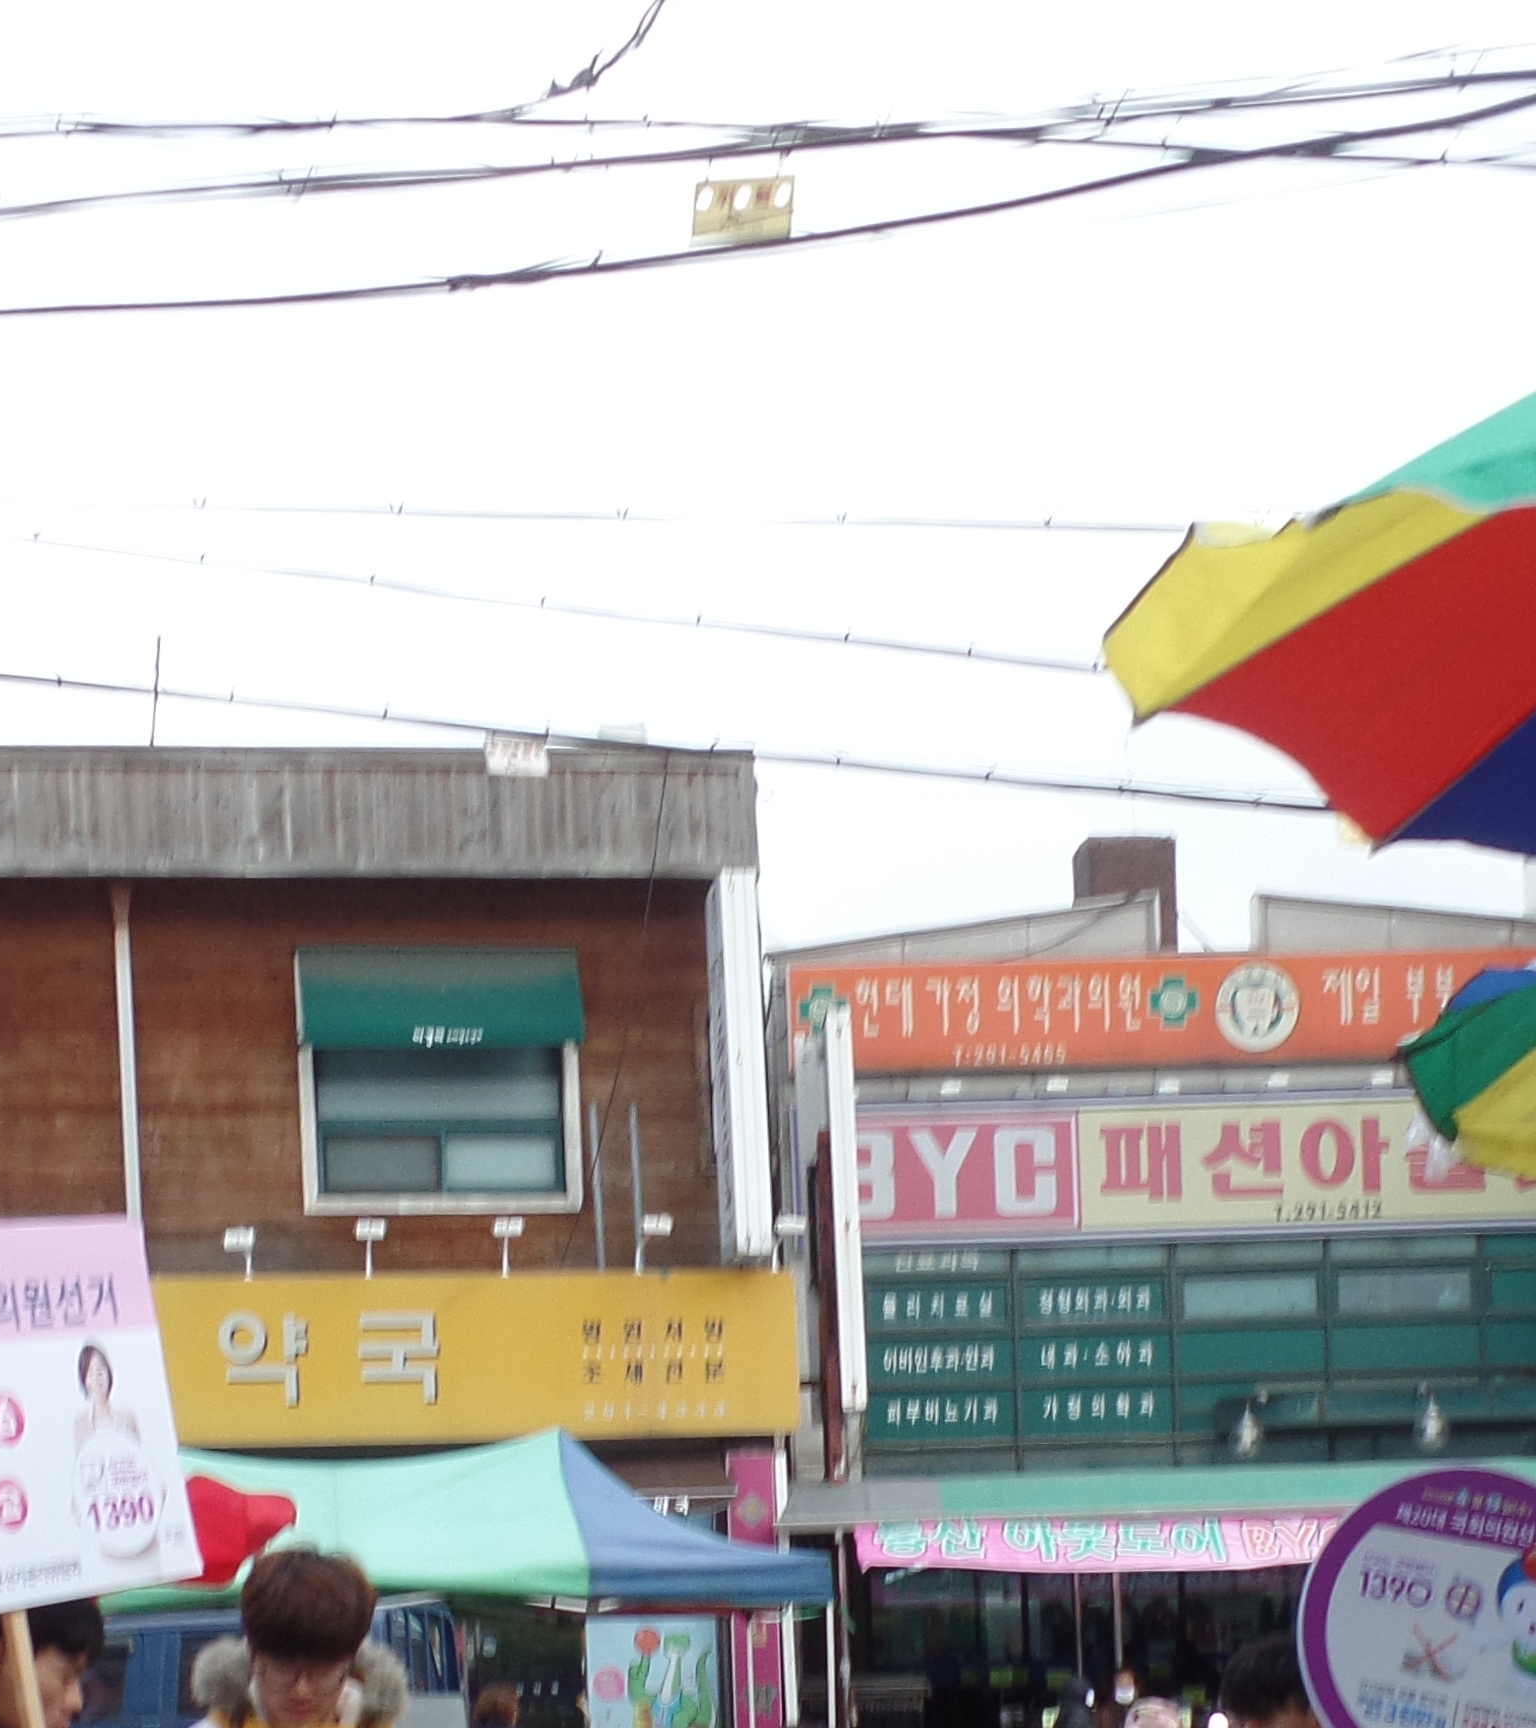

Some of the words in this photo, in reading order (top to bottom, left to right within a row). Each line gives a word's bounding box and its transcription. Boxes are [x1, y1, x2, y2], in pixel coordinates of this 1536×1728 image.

[1322, 966, 1382, 1026] 제일
[857, 1126, 1057, 1219] BYC
[218, 1308, 440, 1408] 약국
[86, 1490, 156, 1532] 1390
[1396, 1501, 1447, 1534] 제20대
[1358, 1567, 1433, 1612] 1390
